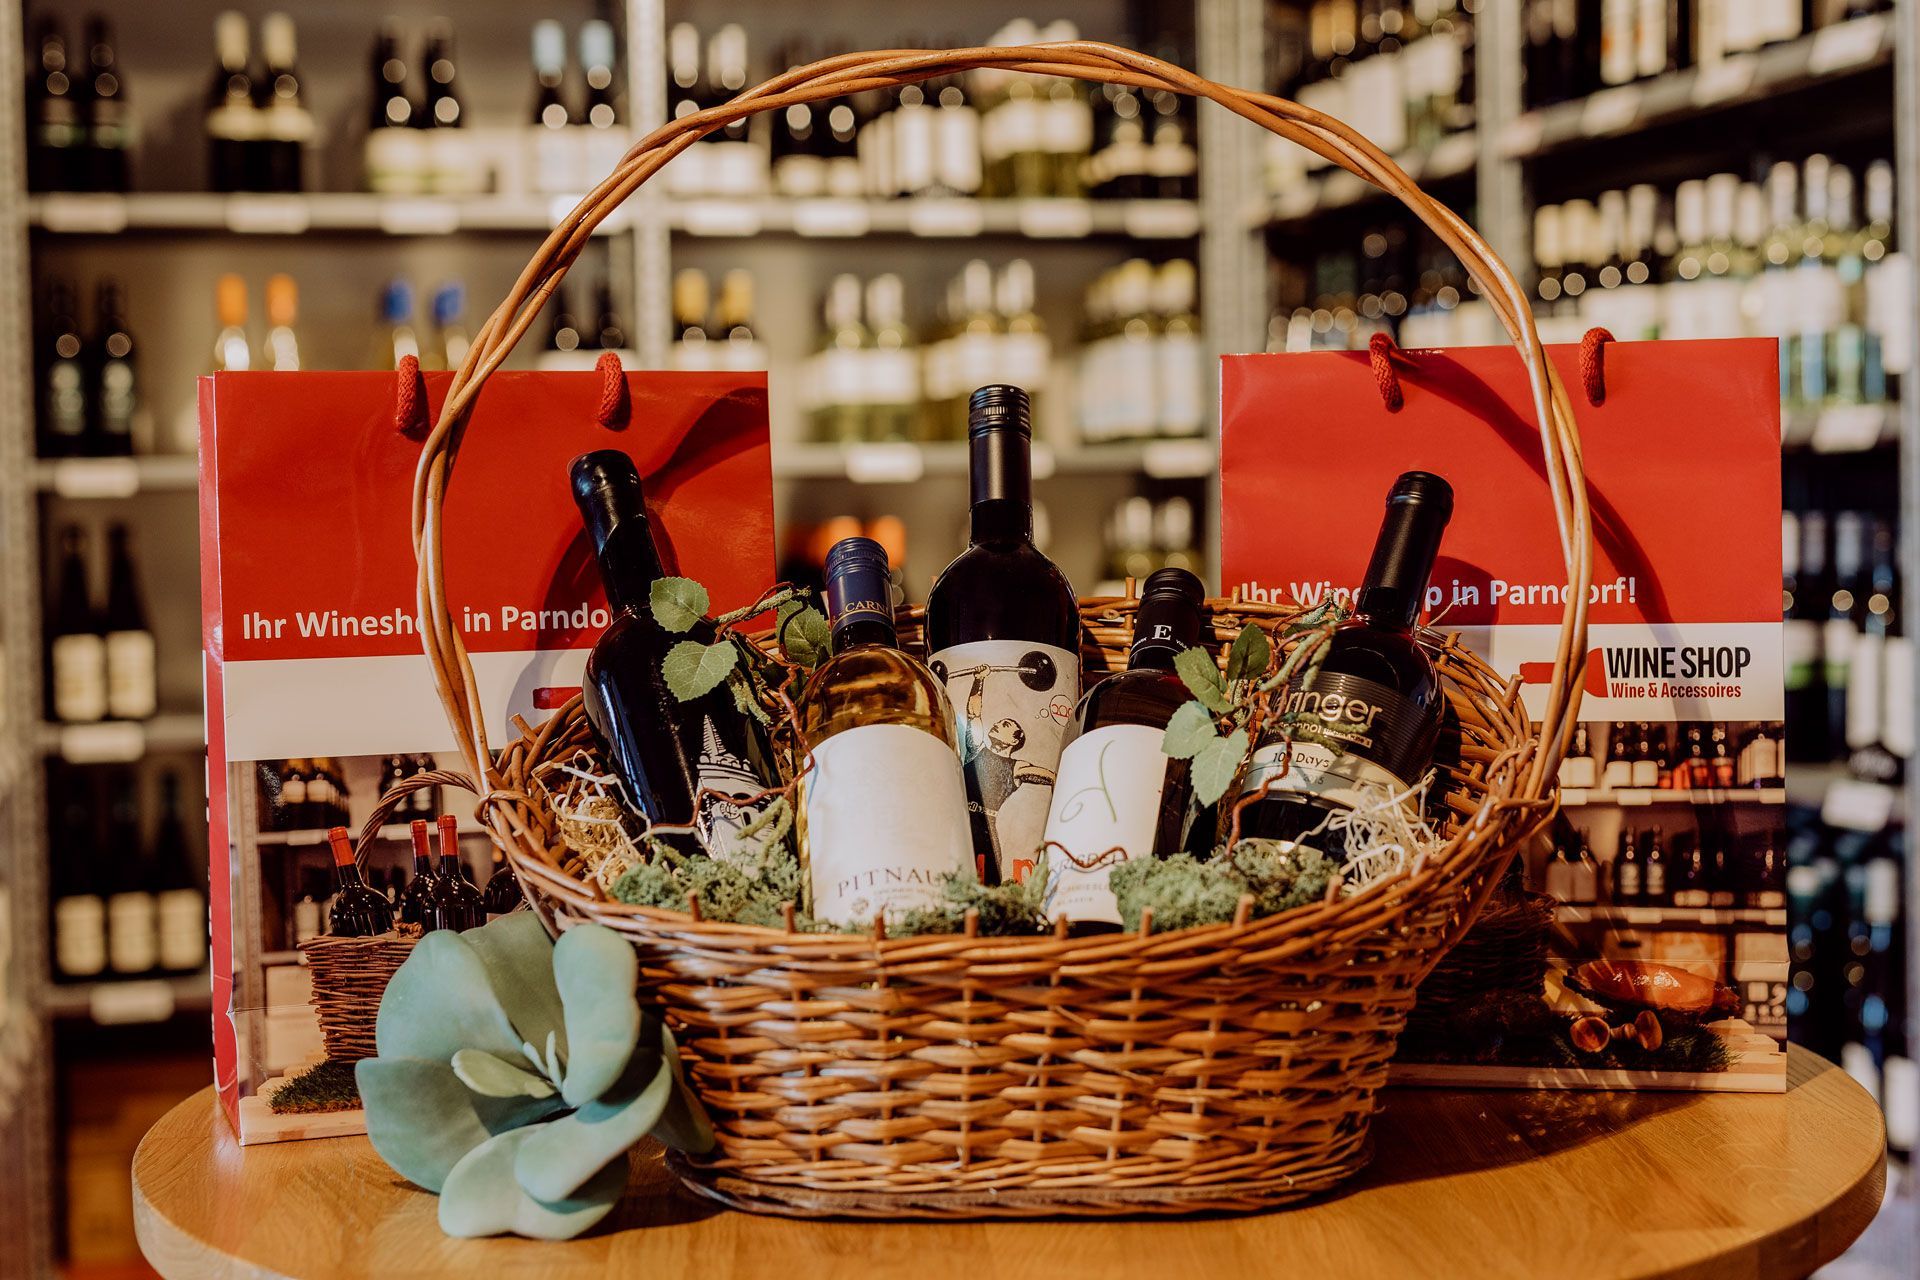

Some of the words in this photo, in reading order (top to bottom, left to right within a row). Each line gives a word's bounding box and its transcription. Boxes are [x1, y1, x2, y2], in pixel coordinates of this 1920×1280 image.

[1241, 581, 1282, 605] Ihr
[1452, 579, 1479, 605] in
[243, 612, 287, 639] Ihr
[295, 608, 420, 638] Winesh
[463, 606, 491, 632] in
[501, 602, 609, 632] Parndo
[1151, 624, 1173, 641] E
[1606, 647, 1677, 679] WINE
[1680, 646, 1751, 679] SHOP
[1611, 683, 1645, 699] Wine
[1648, 682, 1658, 699] &
[1661, 682, 1742, 699] Accessoires
[1284, 691, 1383, 728] ringer
[1295, 752, 1330, 768] Days
